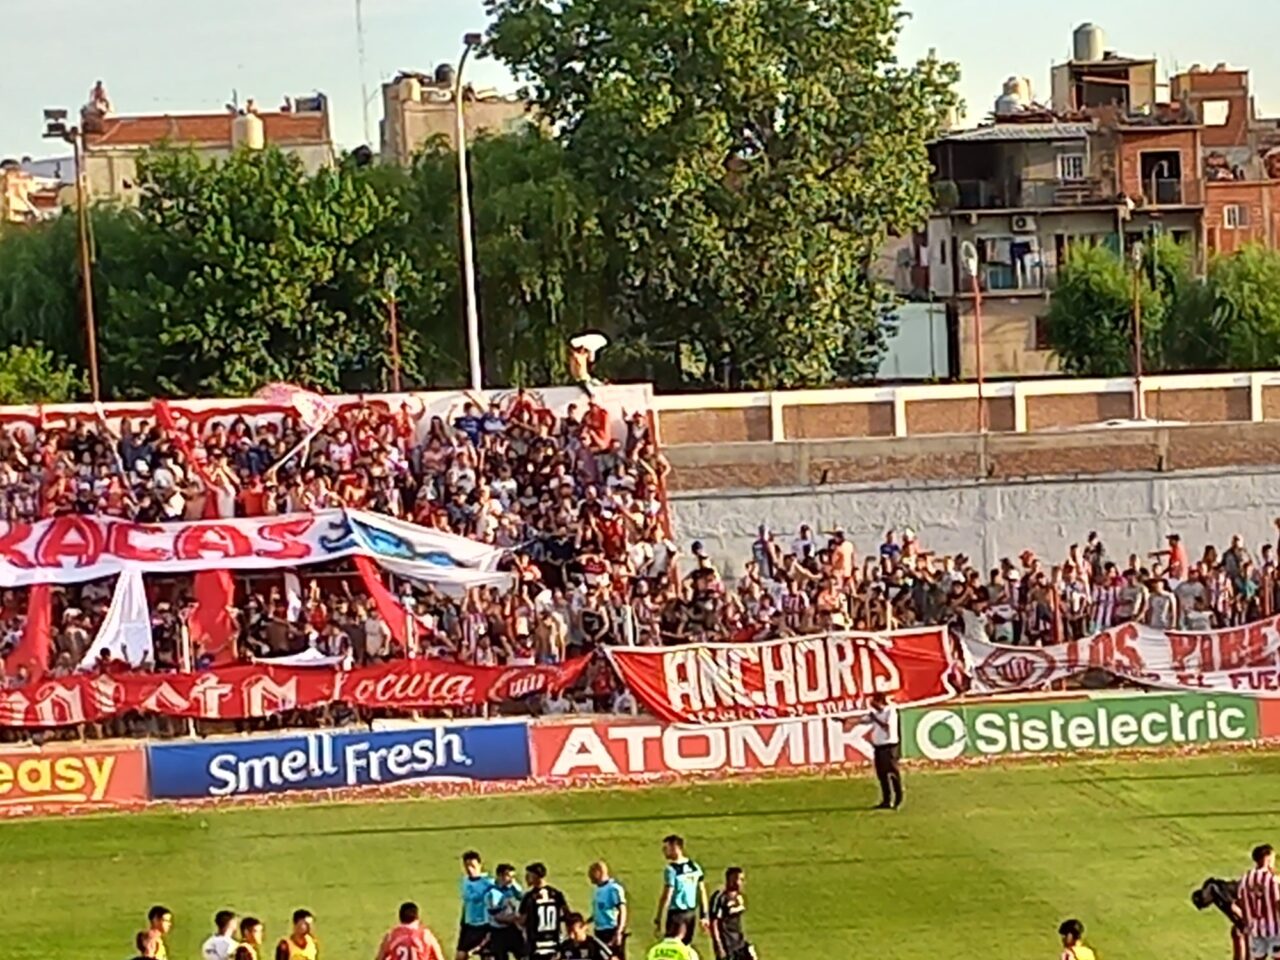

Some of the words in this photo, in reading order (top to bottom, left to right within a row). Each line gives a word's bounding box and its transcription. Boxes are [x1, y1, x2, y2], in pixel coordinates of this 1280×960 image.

[551, 718, 875, 775] ATOMIK
[974, 702, 1246, 754] Sistelectric
[209, 733, 338, 795] Smell
[537, 905, 557, 931] 10
